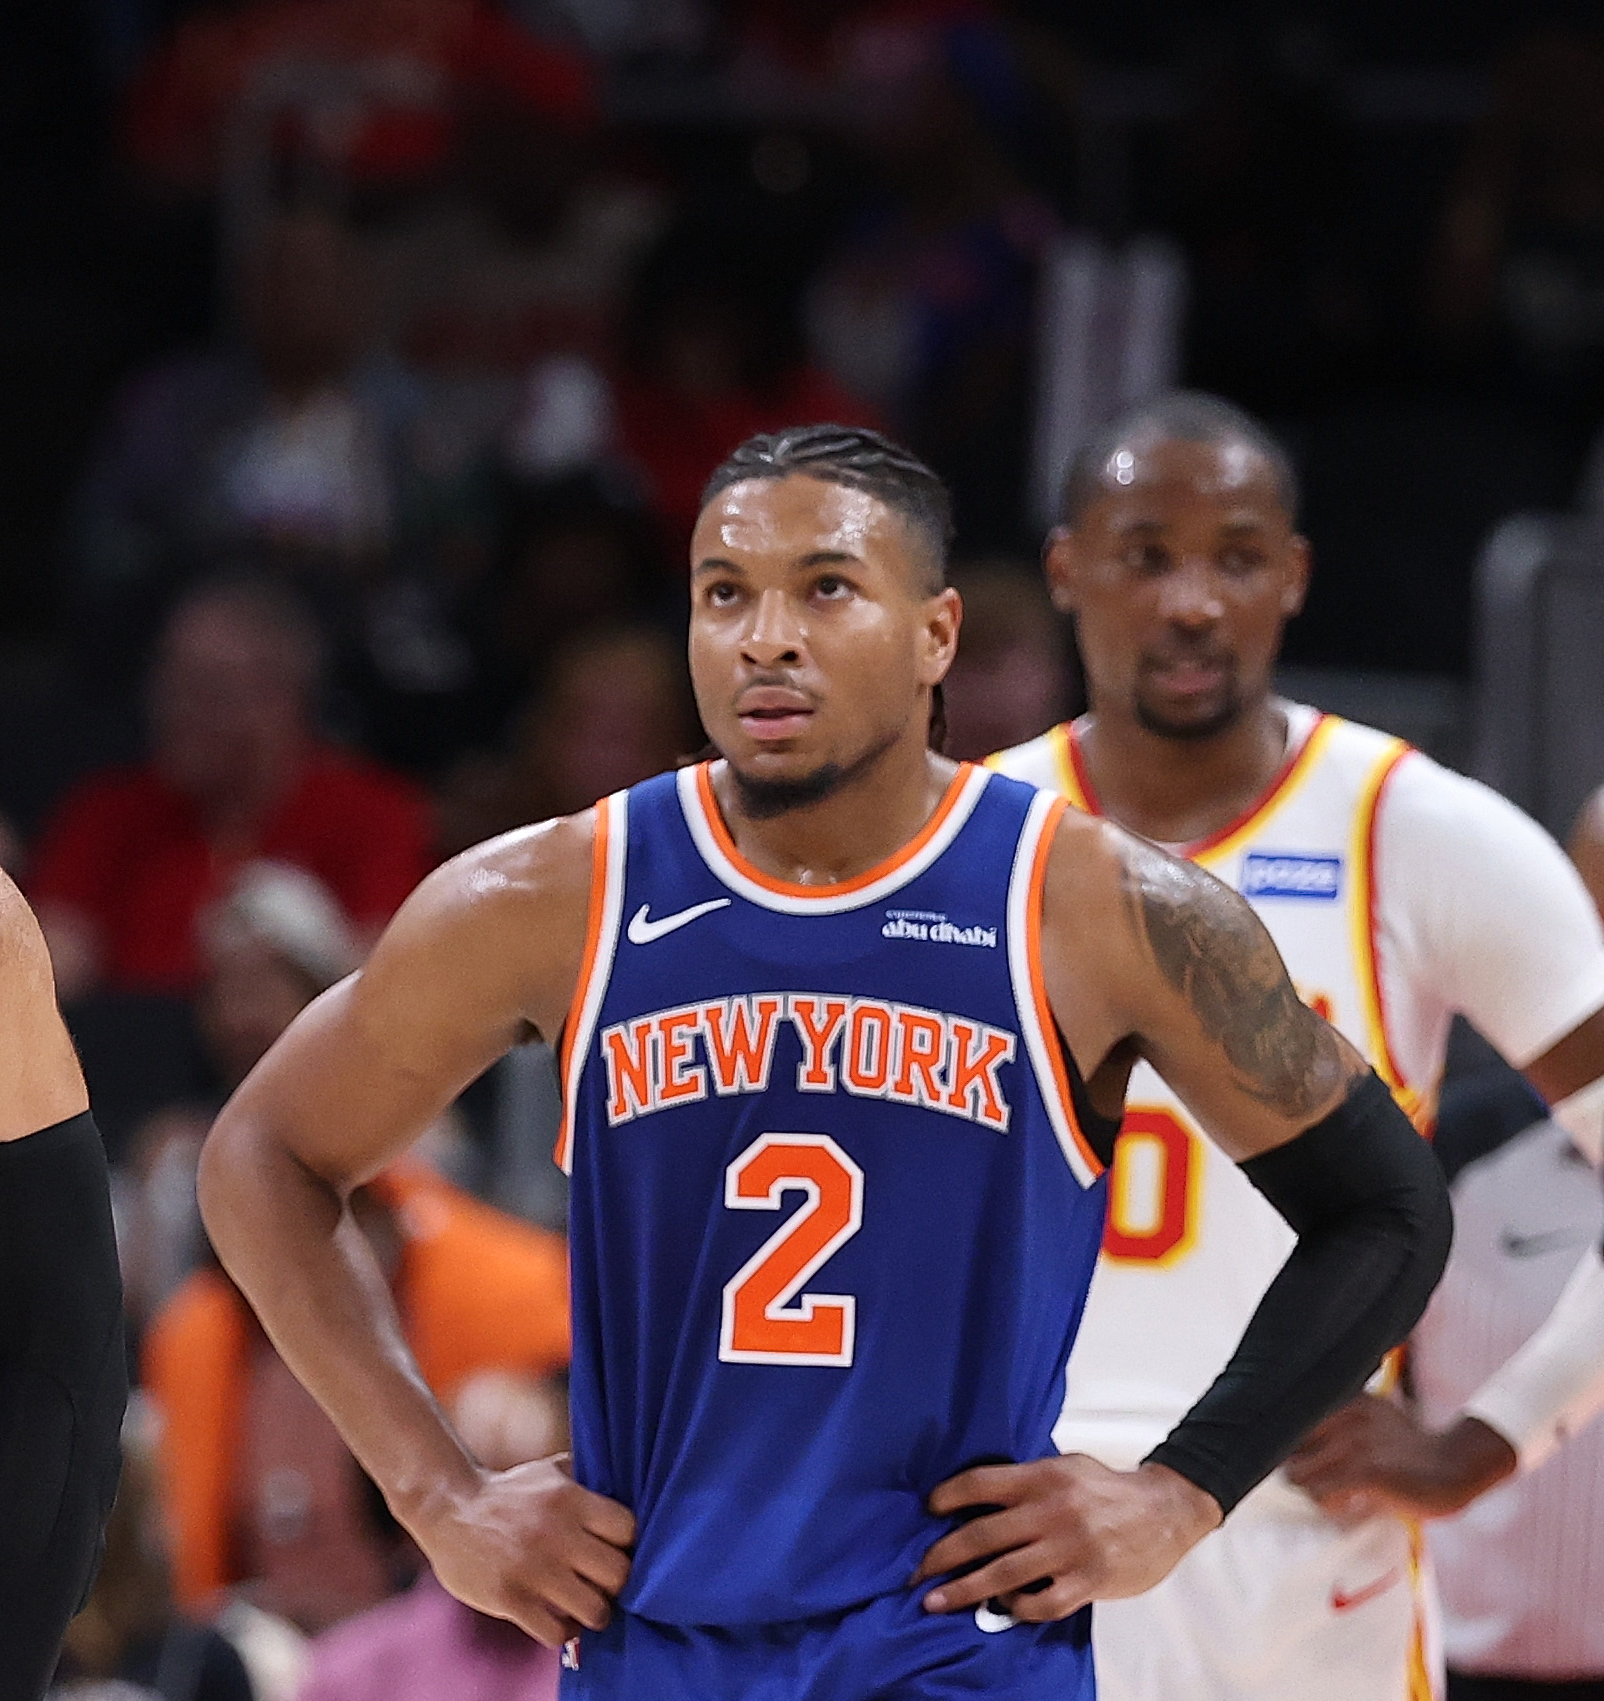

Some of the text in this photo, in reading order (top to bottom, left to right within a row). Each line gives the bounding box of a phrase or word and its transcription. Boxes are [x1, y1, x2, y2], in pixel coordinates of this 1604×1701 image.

[881, 919, 928, 940] abu
[601, 993, 1017, 1134] NEW YORK
[719, 1133, 865, 1367] 2
